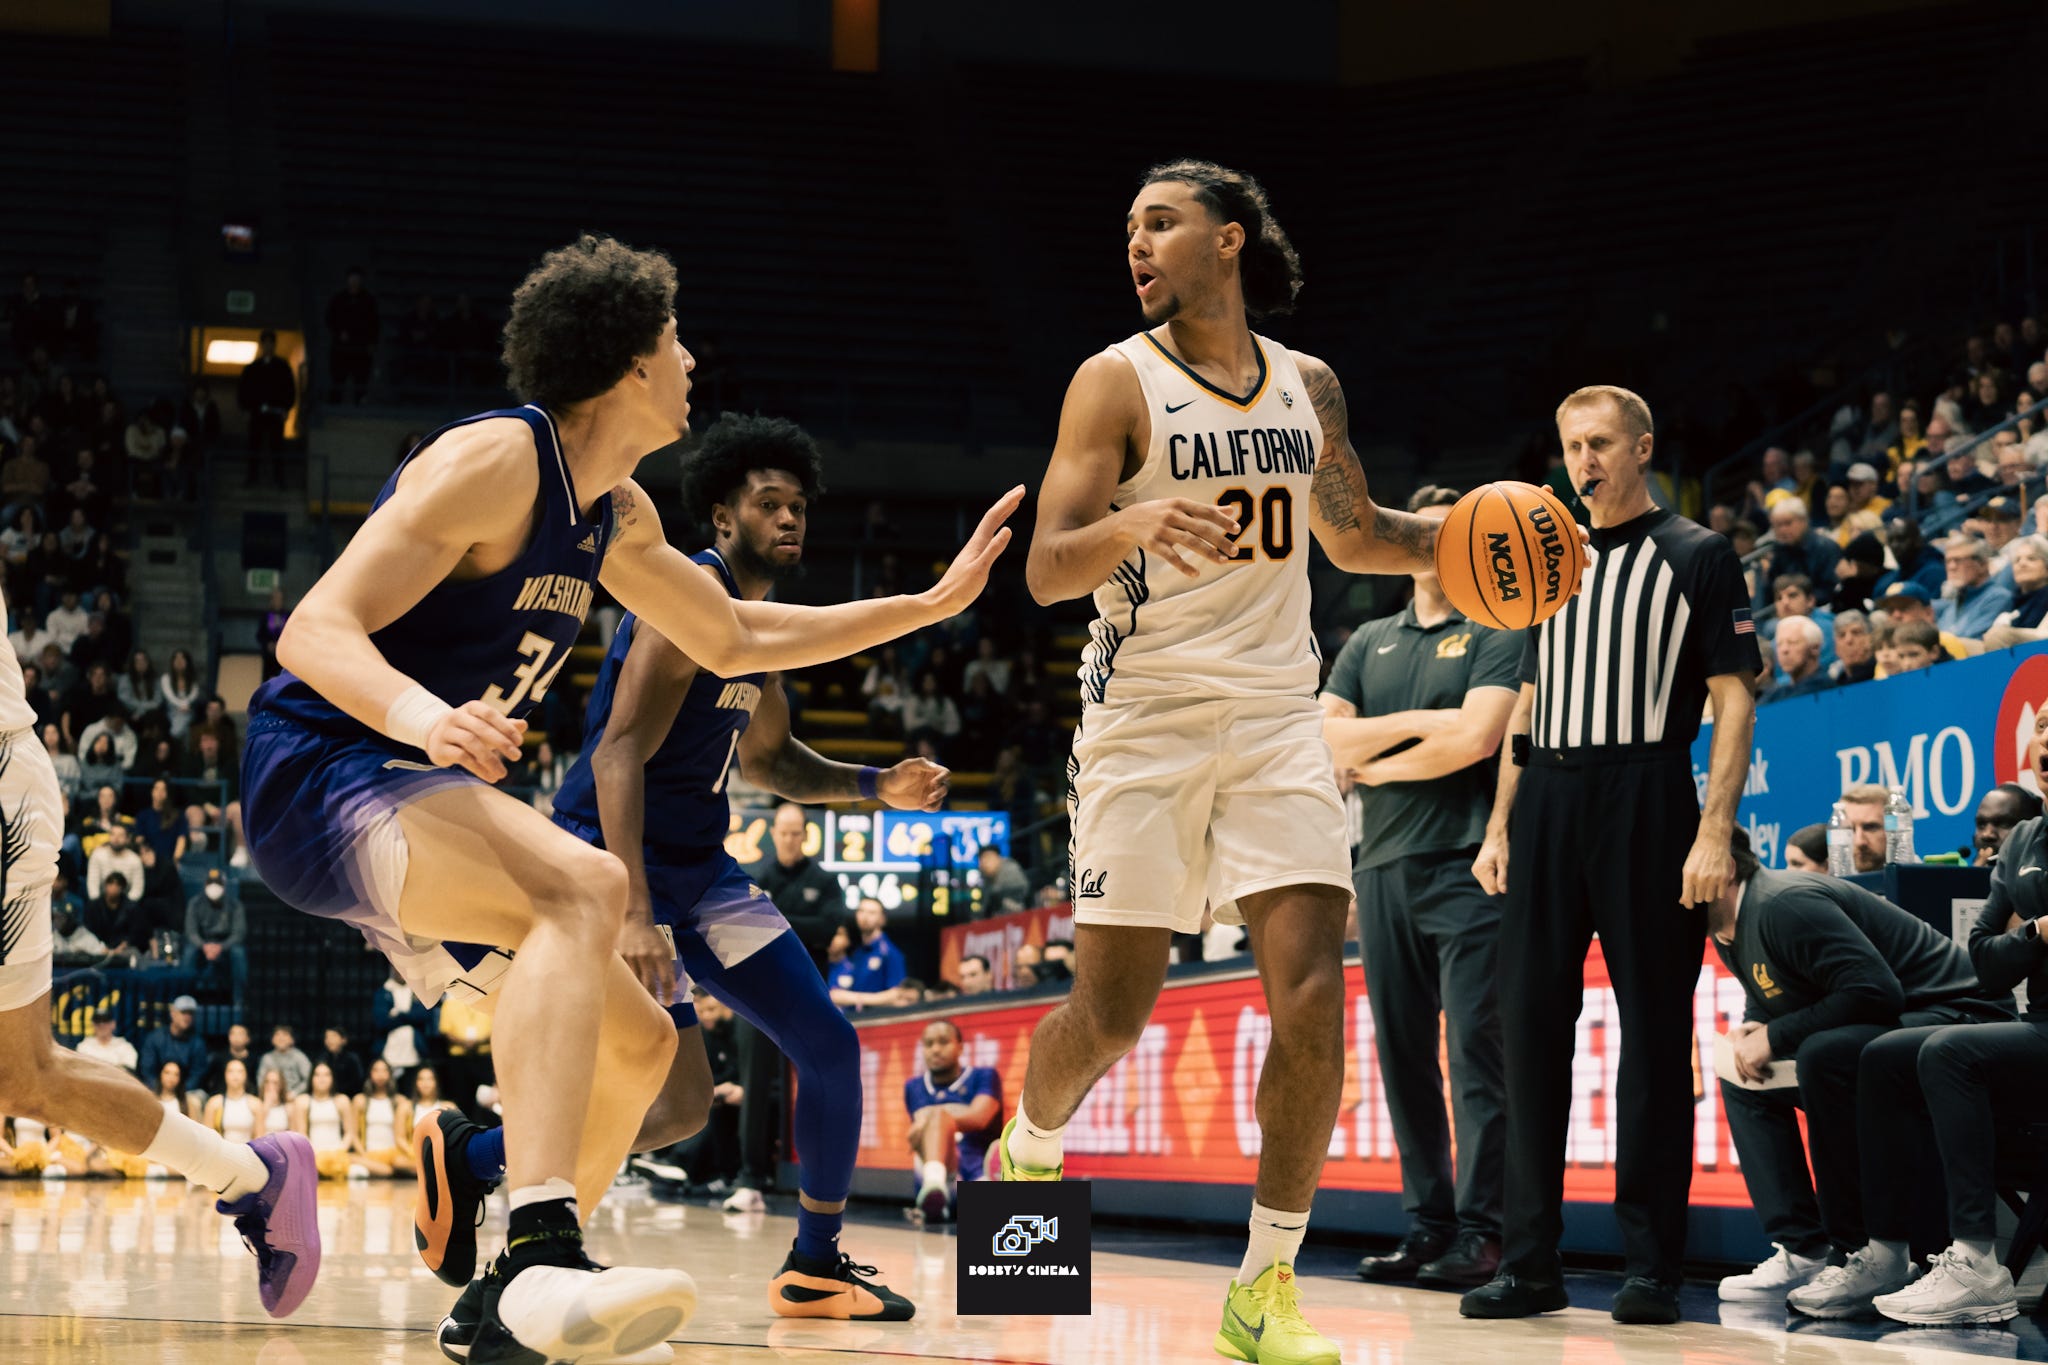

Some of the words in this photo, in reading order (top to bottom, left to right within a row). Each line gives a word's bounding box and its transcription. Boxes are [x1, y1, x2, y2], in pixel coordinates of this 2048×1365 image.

[1169, 428, 1315, 480] CALIFORNIA
[1215, 484, 1293, 564] 20
[1527, 504, 1565, 607] Wilson
[1487, 532, 1522, 602] NCAA
[1079, 868, 1108, 898] Cal
